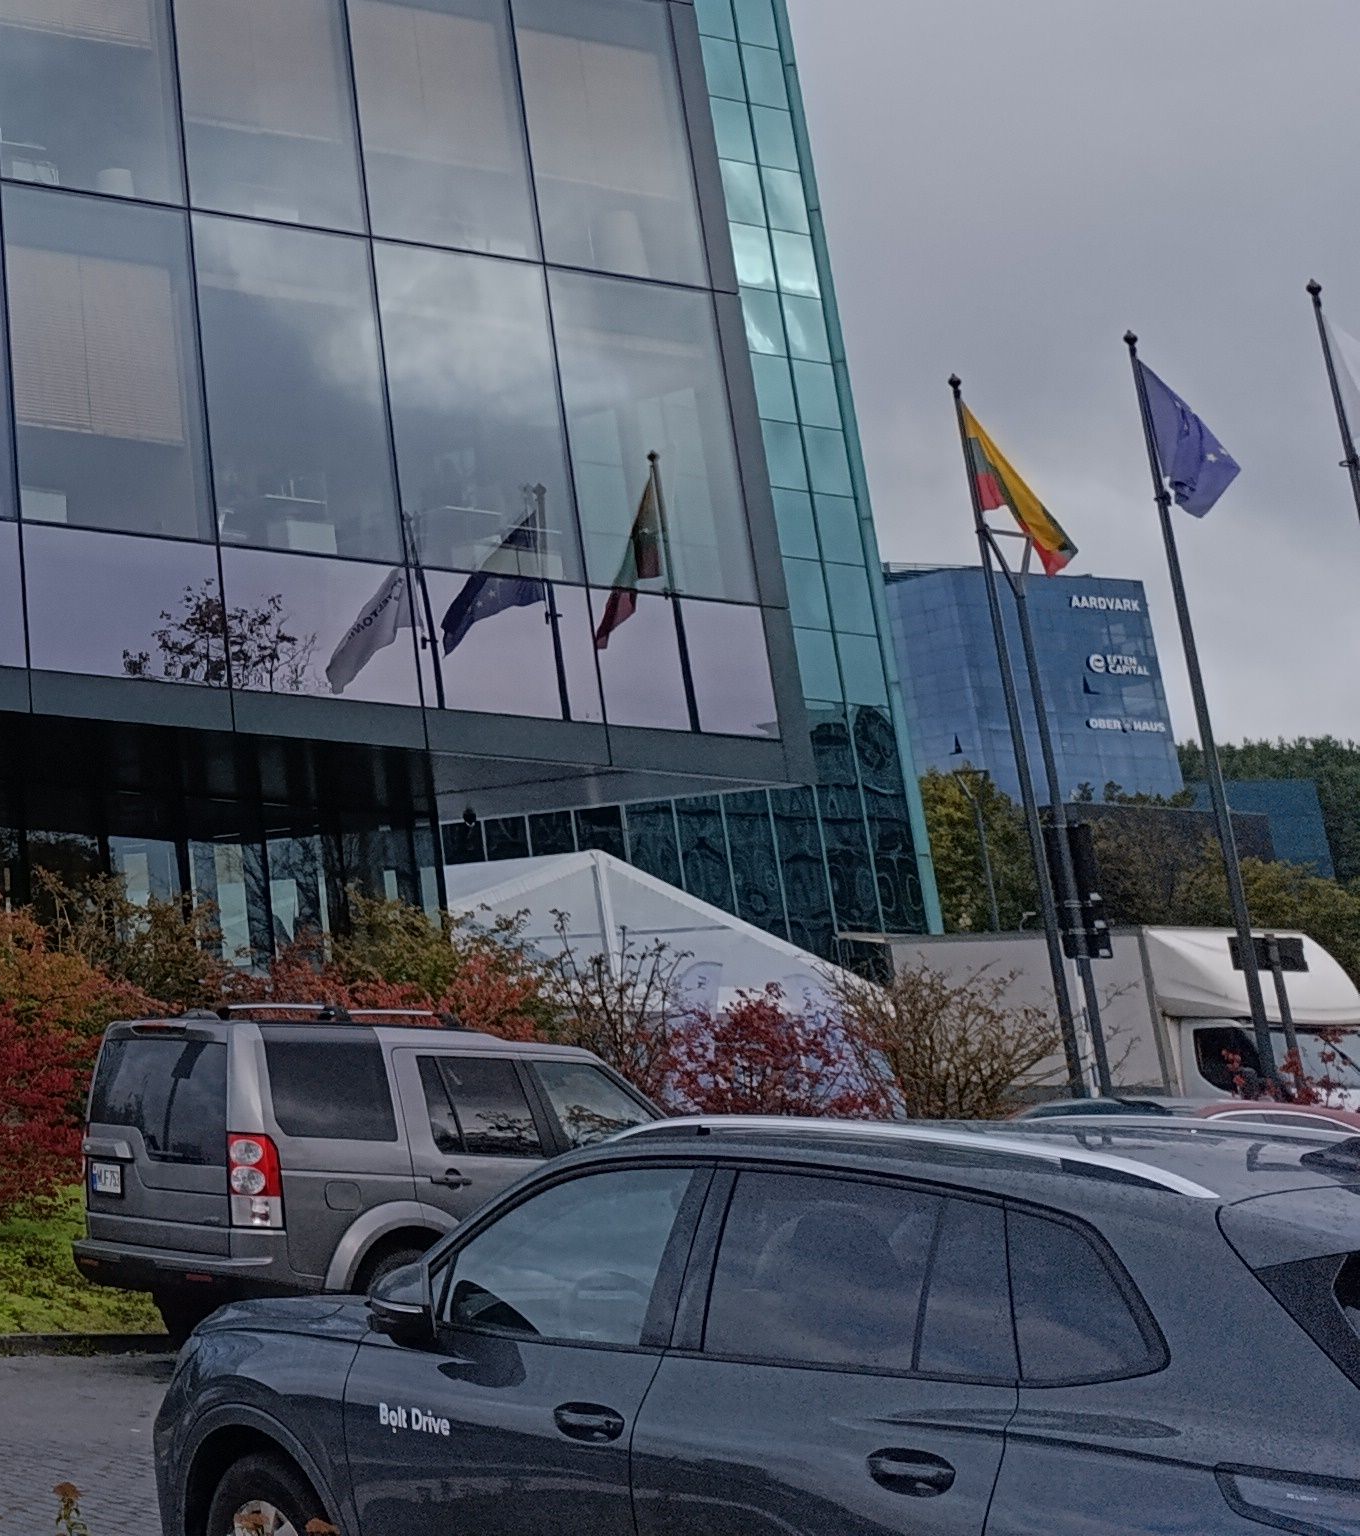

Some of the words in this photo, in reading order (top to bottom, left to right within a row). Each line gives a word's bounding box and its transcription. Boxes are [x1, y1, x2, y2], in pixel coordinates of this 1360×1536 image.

[1071, 595, 1141, 612] AARDVARK
[1109, 664, 1150, 676] CAPITAL
[1088, 718, 1122, 730] OBER
[1133, 719, 1166, 732] HAUS
[379, 1402, 408, 1434] Bolt
[411, 1407, 450, 1436] Drive
